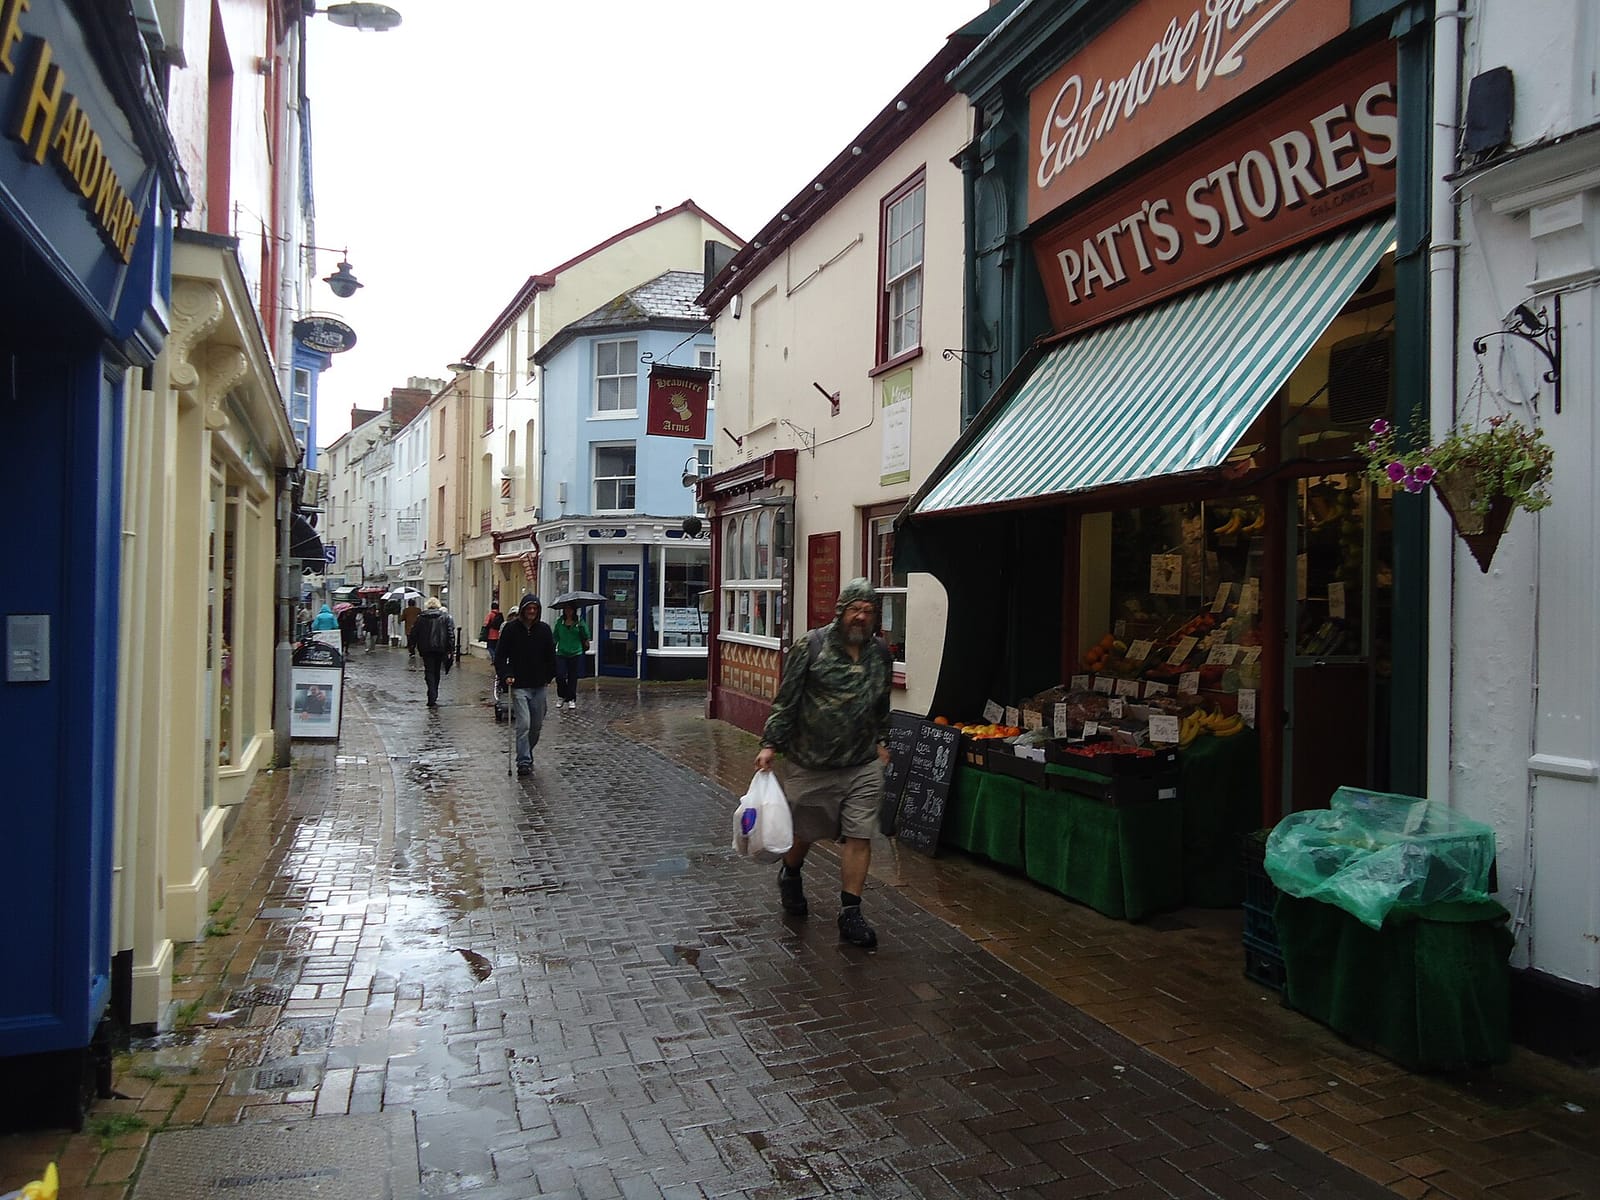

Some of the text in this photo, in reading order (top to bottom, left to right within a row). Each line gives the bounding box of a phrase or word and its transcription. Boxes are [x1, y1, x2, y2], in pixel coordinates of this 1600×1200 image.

[20, 39, 140, 265] HARDWARE
[1036, 10, 1200, 189] Eatmore
[1056, 81, 1397, 304] PATT'S STORES
[662, 420, 690, 433] Arms
